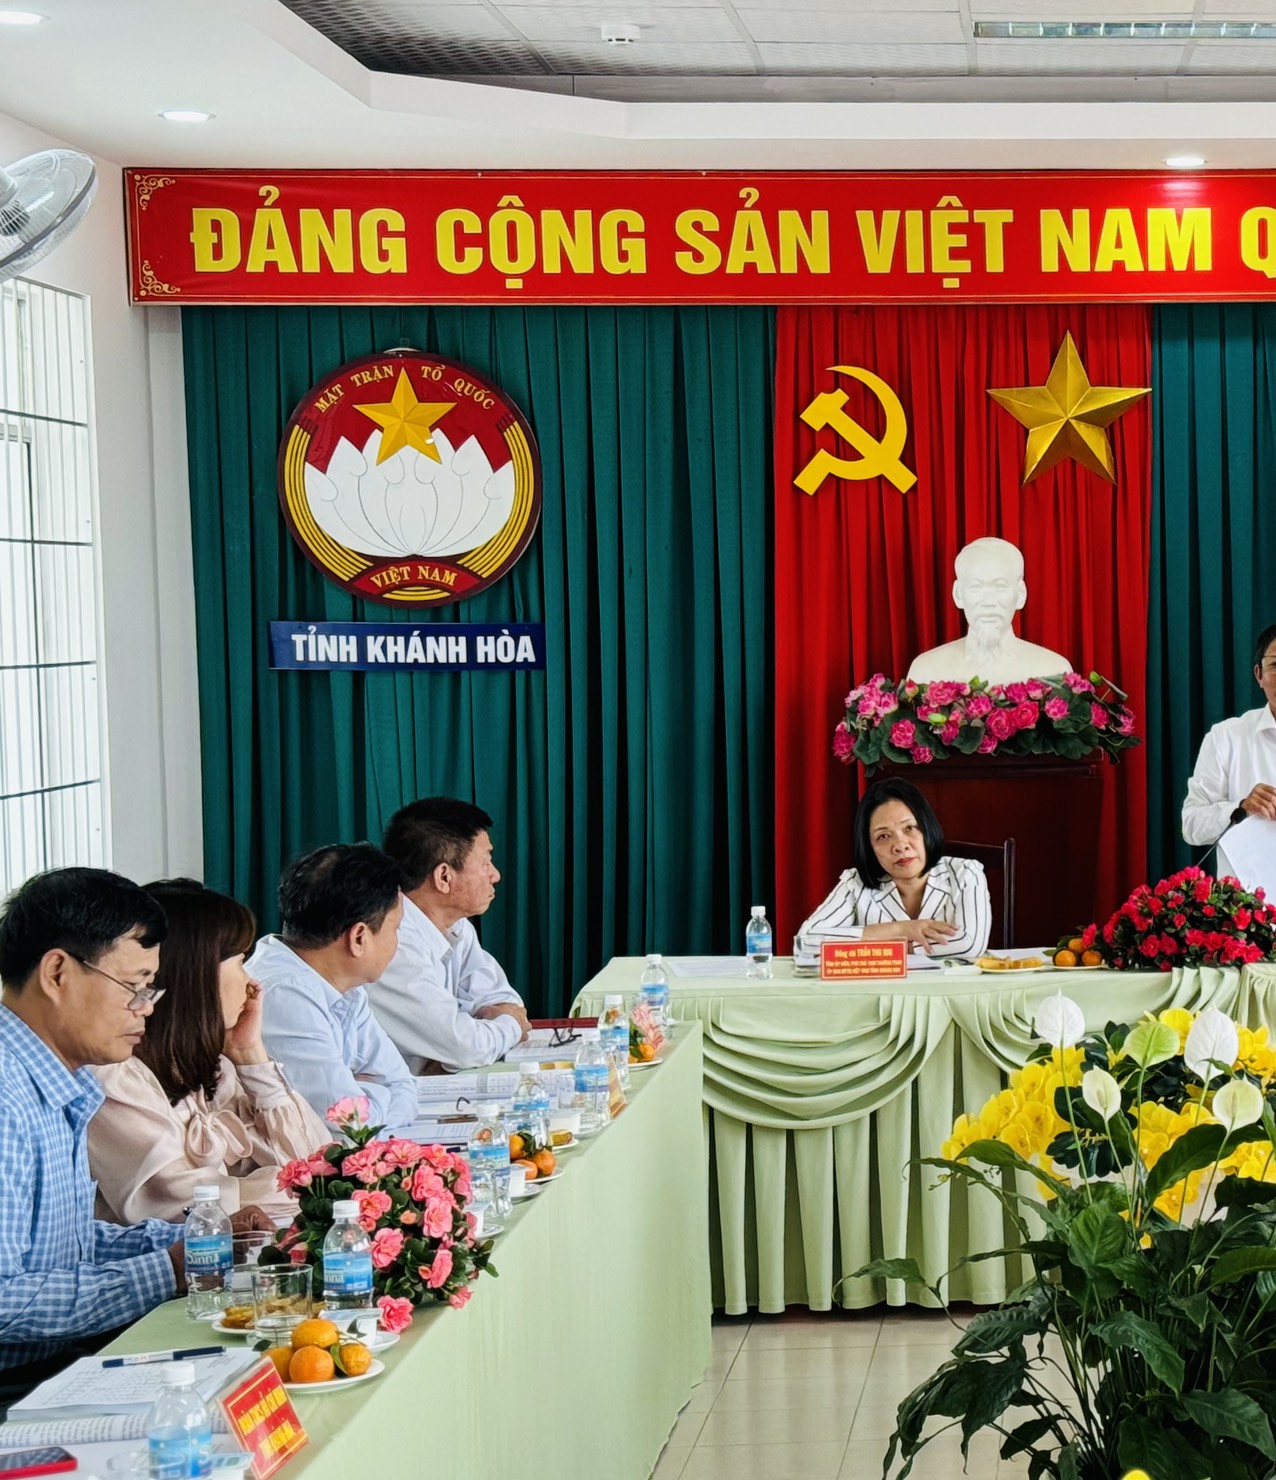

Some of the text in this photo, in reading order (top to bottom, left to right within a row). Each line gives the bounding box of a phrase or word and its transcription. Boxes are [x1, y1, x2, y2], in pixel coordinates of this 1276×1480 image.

[189, 185, 407, 273] ĐẢNG
[435, 195, 647, 288] CỘNG
[675, 187, 831, 273] SẢN
[855, 196, 1014, 288] VIỆT
[1040, 207, 1213, 271] NAM
[314, 364, 496, 414] MẶT TRẬN TỔ QUỐC
[369, 565, 458, 588] VIỆT NAM
[291, 625, 536, 664] TỈNH KHÁNH HÒA
